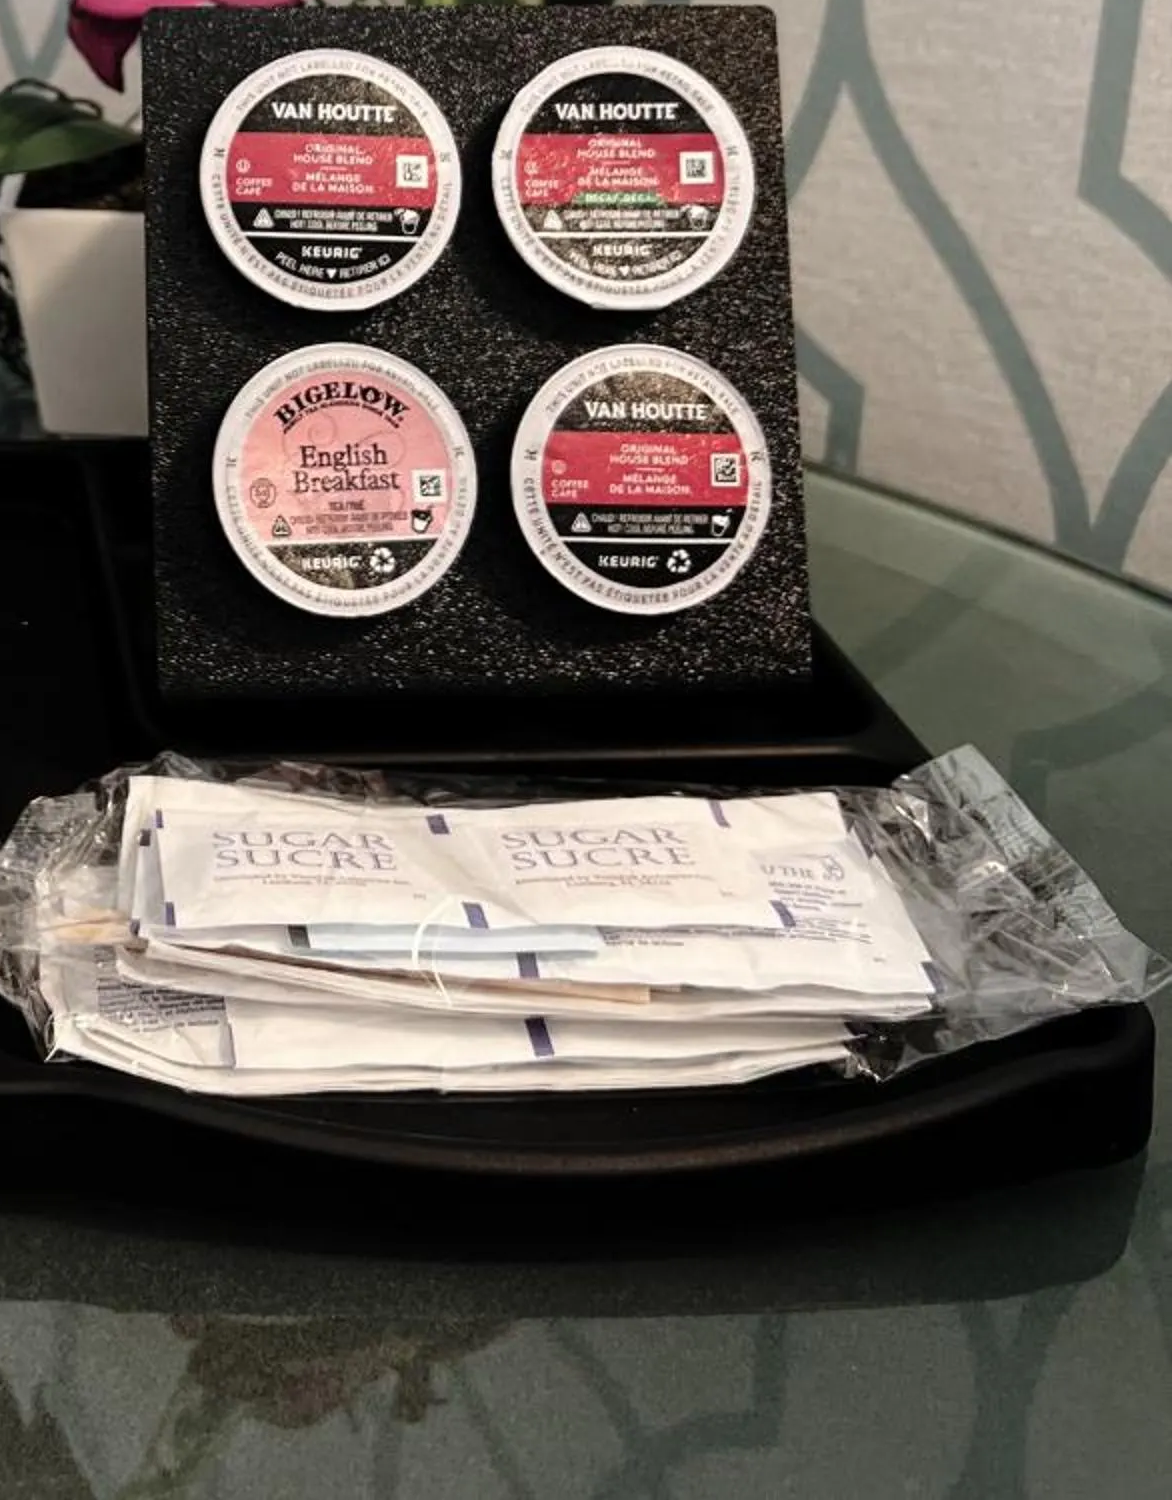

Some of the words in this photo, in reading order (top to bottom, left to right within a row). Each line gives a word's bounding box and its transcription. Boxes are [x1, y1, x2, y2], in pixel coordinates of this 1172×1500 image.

[272, 102, 314, 120] VAN
[318, 103, 396, 123] HOUTTE
[555, 103, 596, 120] VAN
[599, 103, 678, 120] HOUTTE
[305, 143, 366, 155] ORIGINAL
[577, 148, 617, 159] HOUSE
[619, 149, 656, 159] BLEND
[293, 154, 333, 164] HOUSE
[336, 155, 373, 165] BLEND
[292, 182, 307, 192] DE
[310, 182, 325, 192] LA
[327, 183, 374, 194] MAISON
[597, 176, 611, 186] LA
[301, 245, 361, 259] KEURIG
[274, 252, 297, 271] PEEL
[273, 382, 410, 426] BIGELOW
[585, 401, 626, 420] VAN
[631, 402, 709, 420] HOUTTE
[620, 444, 676, 455] ORIGINAL
[300, 444, 388, 473] English
[609, 455, 650, 465] HOUSE
[652, 455, 689, 465] BLEND
[292, 468, 401, 494] Breakfast
[609, 485, 624, 494] DE
[627, 485, 642, 494] LA
[645, 485, 691, 495] MAISON
[599, 555, 659, 568] KEURIG
[212, 831, 395, 850] SUGAR
[501, 828, 688, 848] SUGAR
[216, 850, 397, 870] SUCRE
[512, 848, 696, 870] SUCRE
